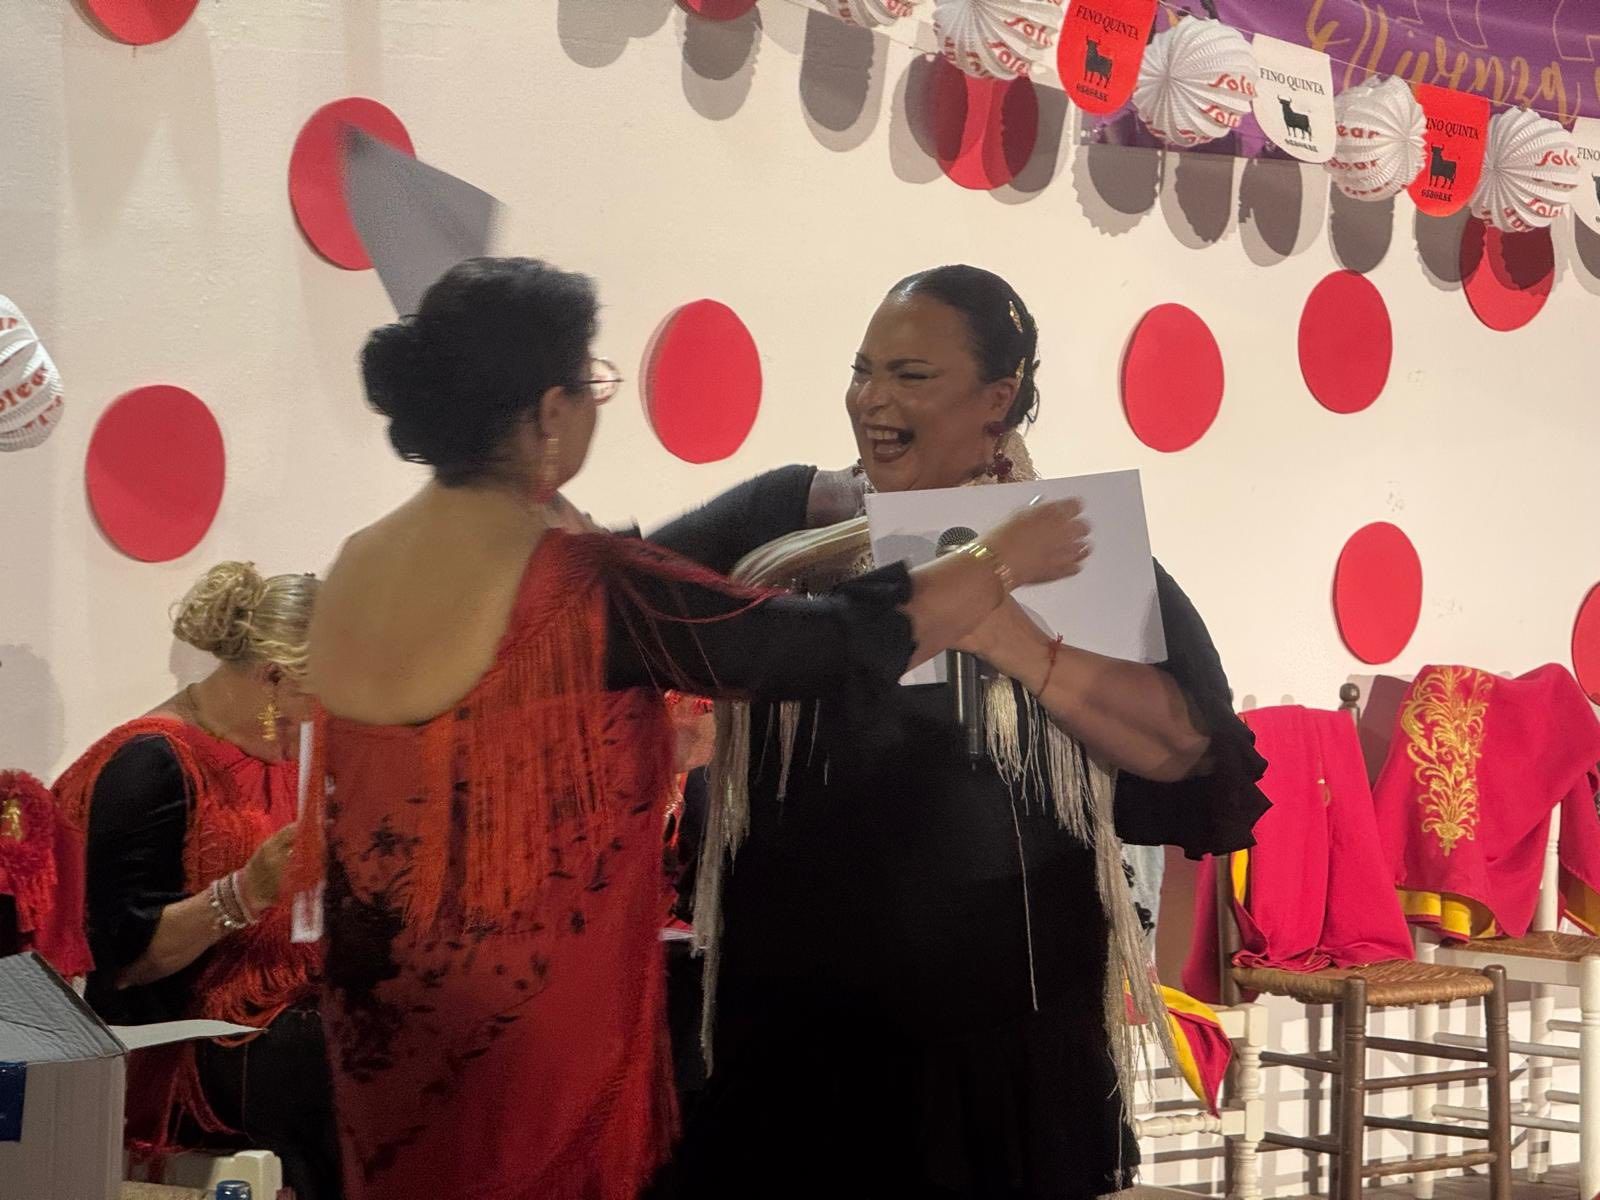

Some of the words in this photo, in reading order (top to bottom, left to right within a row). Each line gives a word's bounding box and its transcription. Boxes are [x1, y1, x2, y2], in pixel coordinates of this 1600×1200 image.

[1076, 5, 1102, 25] FINO
[1102, 15, 1139, 41] QUINTA
[1260, 67, 1285, 84] FINO
[1286, 75, 1325, 95] QUINTA
[1335, 125, 1380, 139] ear
[1426, 117, 1445, 132] INO
[1445, 121, 1479, 140] QUINTA
[1577, 146, 1600, 161] FINO
